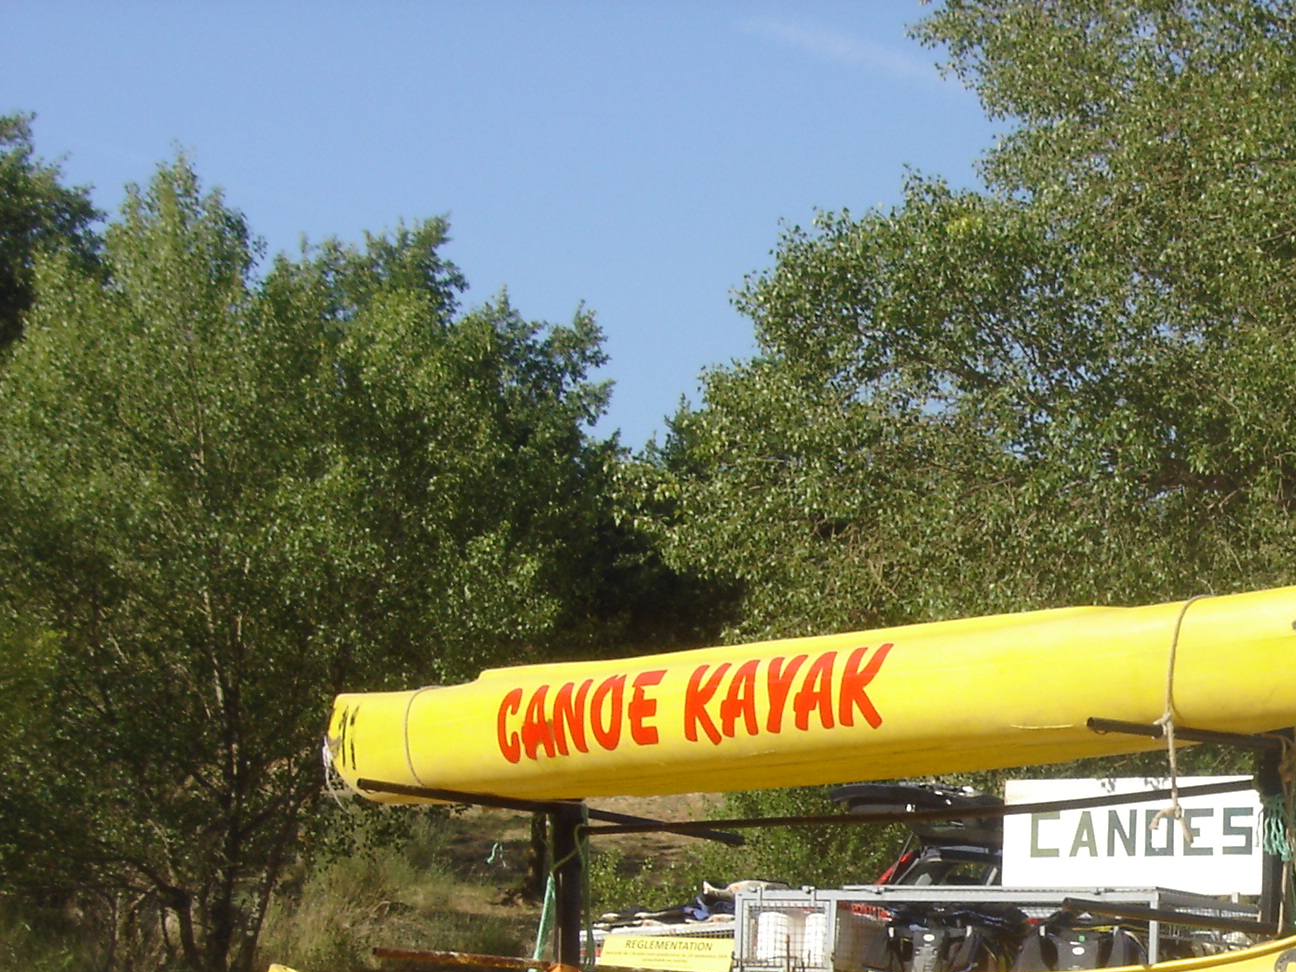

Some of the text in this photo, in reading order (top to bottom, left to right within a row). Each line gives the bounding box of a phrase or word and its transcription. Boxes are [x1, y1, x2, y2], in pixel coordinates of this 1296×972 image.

[497, 643, 894, 763] CANOE KAYAK
[1030, 807, 1254, 858] CANOES
